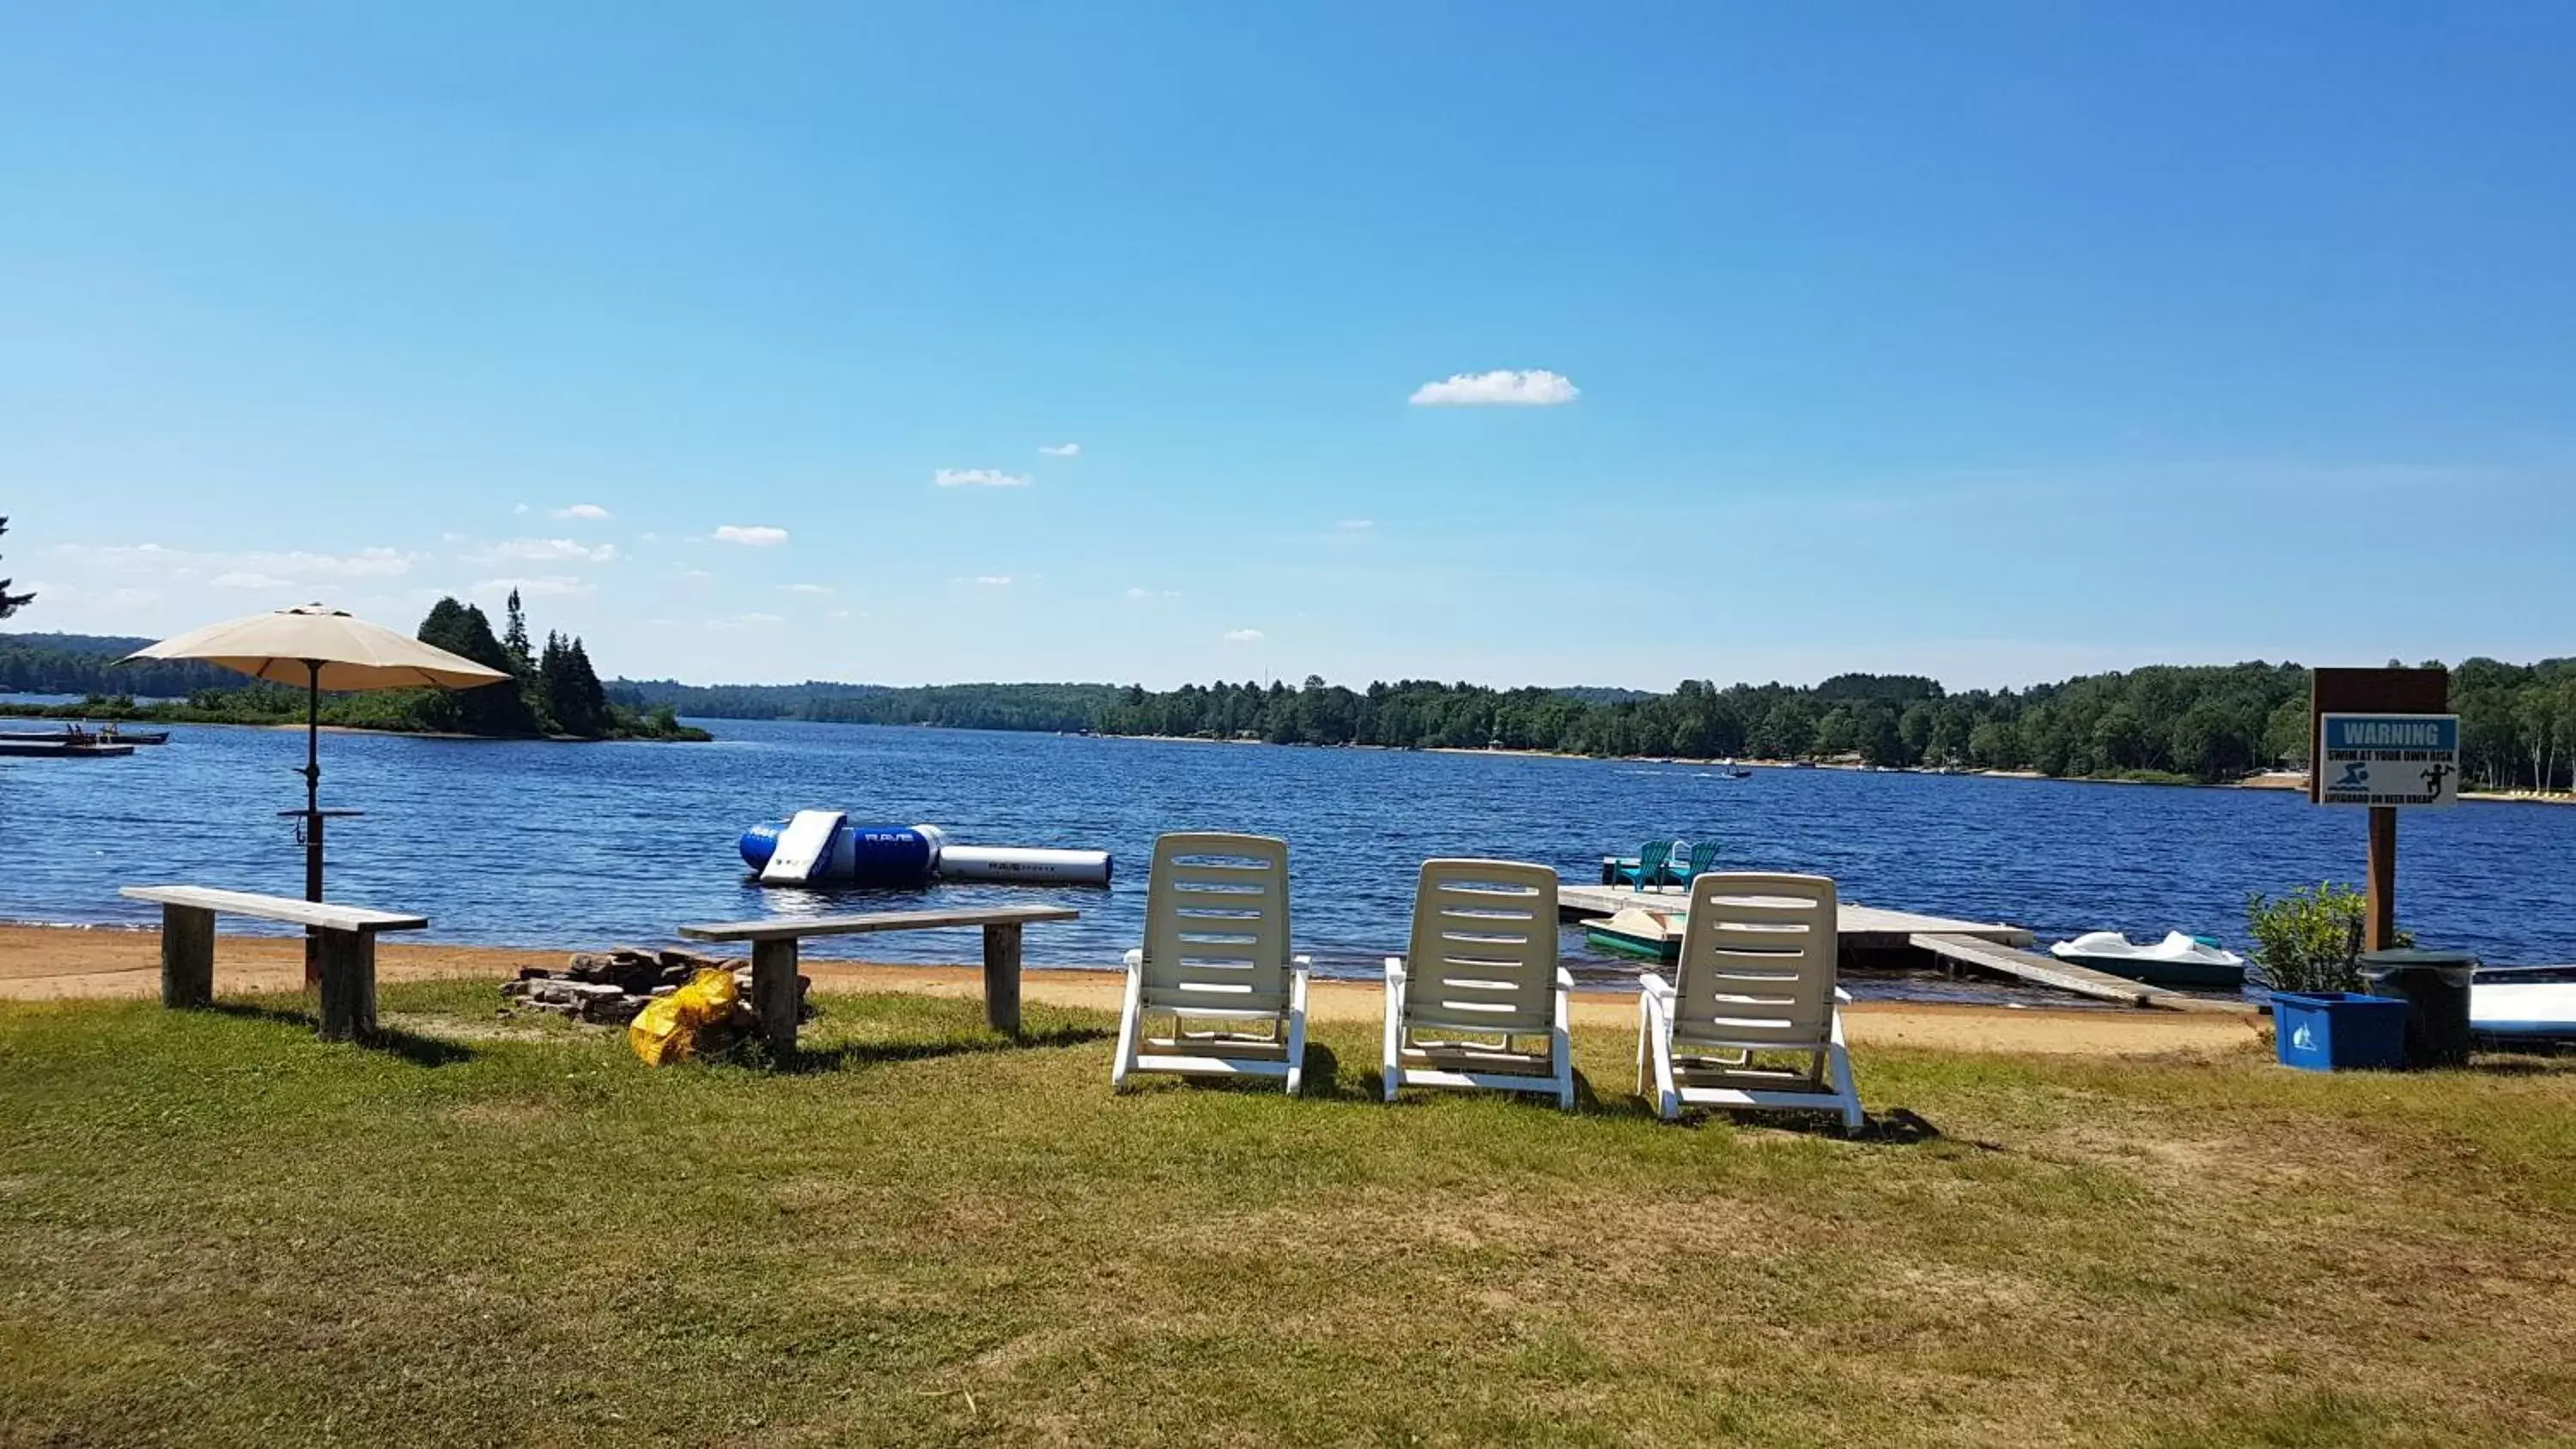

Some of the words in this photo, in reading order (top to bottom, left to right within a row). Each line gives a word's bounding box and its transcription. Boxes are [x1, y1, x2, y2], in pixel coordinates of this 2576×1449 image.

[2343, 722, 2439, 745] WARNING
[2328, 749, 2357, 761] SWIM
[2360, 749, 2371, 761] AT
[2375, 749, 2402, 761] YOUR
[2404, 749, 2427, 761] OWN
[2430, 750, 2453, 761] RISK
